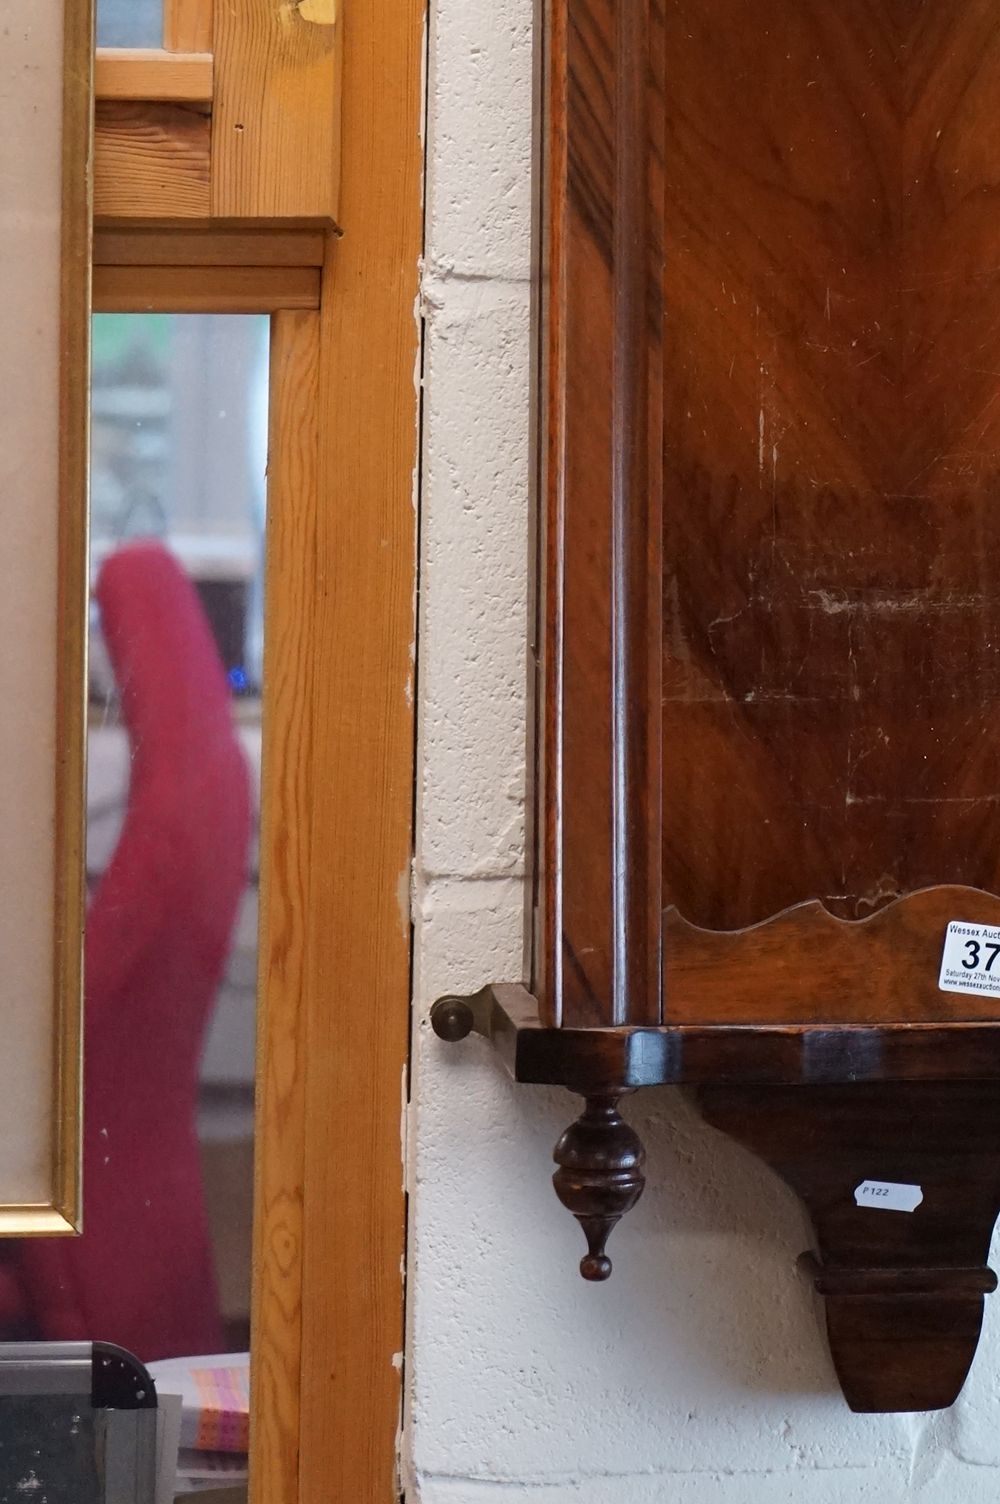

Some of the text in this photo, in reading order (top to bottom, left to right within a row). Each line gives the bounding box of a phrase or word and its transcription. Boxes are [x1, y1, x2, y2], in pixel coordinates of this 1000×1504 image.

[949, 925, 980, 937] Wessex
[945, 968, 972, 980] Saturday
[973, 972, 987, 980] 27th
[862, 1186, 890, 1197] P122
